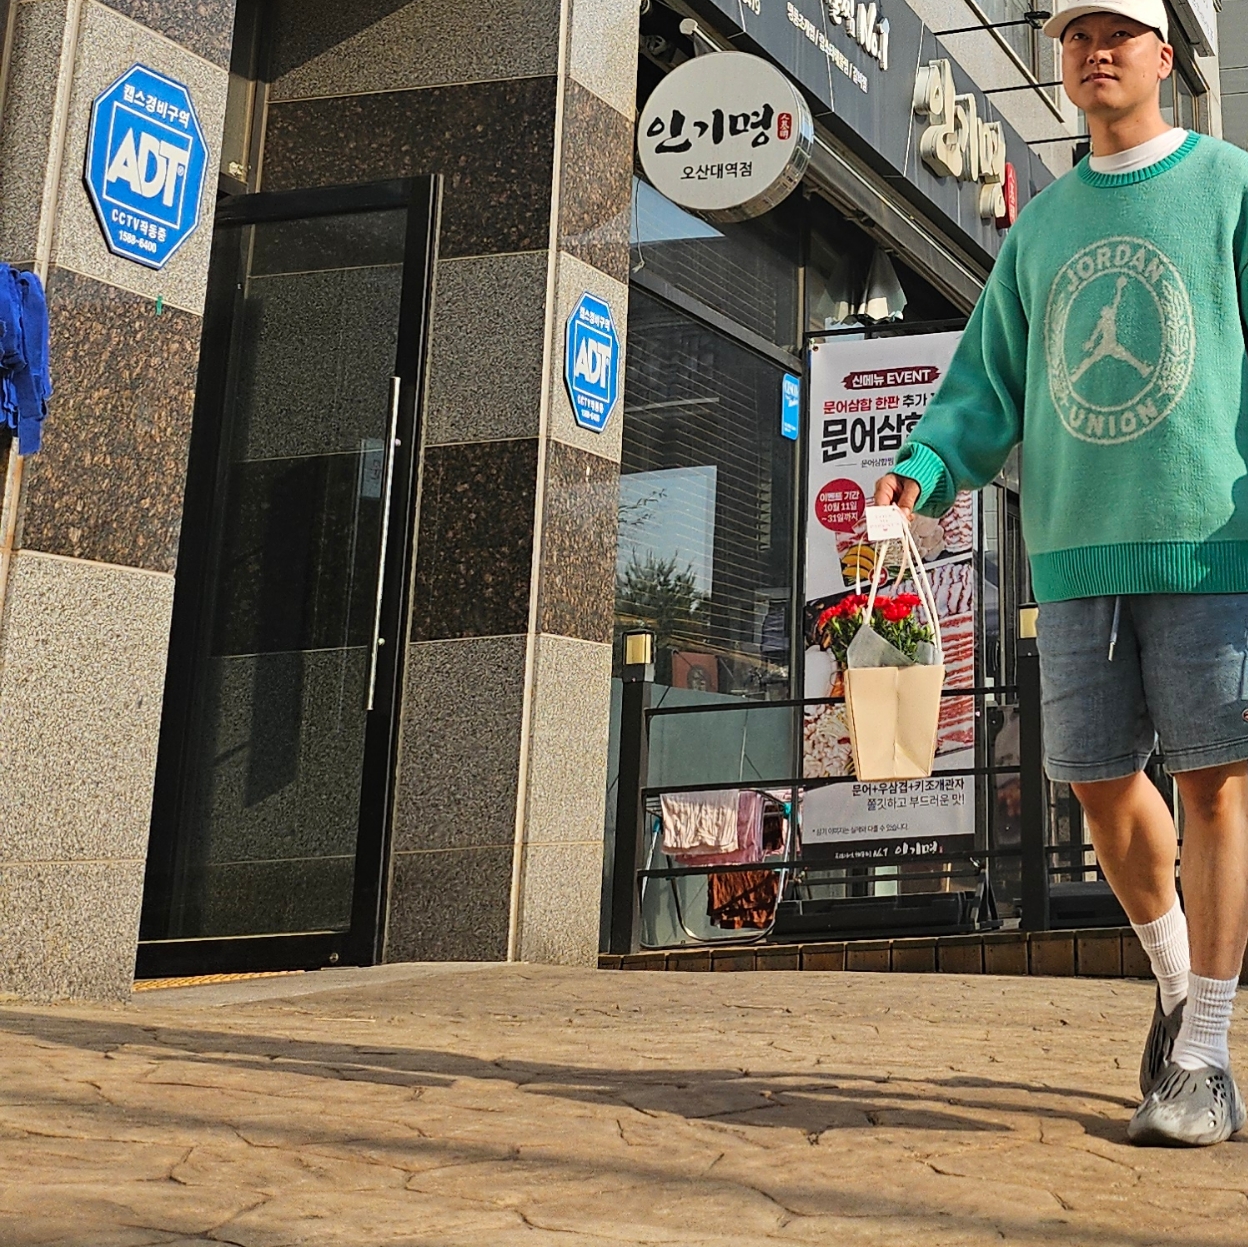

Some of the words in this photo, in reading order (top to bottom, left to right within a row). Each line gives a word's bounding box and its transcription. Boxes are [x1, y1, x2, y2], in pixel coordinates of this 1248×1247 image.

[122, 83, 191, 129] 캡스경비구역
[646, 103, 775, 154] 인기명
[913, 57, 1007, 220] 인기명
[106, 127, 190, 208] ADT
[680, 161, 753, 181] 오산대역점
[111, 208, 168, 243] CCTV작동중
[1065, 243, 1166, 293] JORDAN
[574, 336, 612, 389] ADT
[851, 373, 884, 389] 신메뉴
[886, 368, 932, 385] EVENT
[822, 397, 873, 415] 문어삼합
[875, 395, 900, 411] 한판
[902, 392, 928, 408] 추가
[1068, 397, 1160, 437] UNION
[823, 502, 839, 513] 10월
[840, 500, 858, 512] 11일
[843, 490, 860, 502] 기간
[909, 793, 950, 809] 부드러운
[951, 792, 966, 806] 맛!
